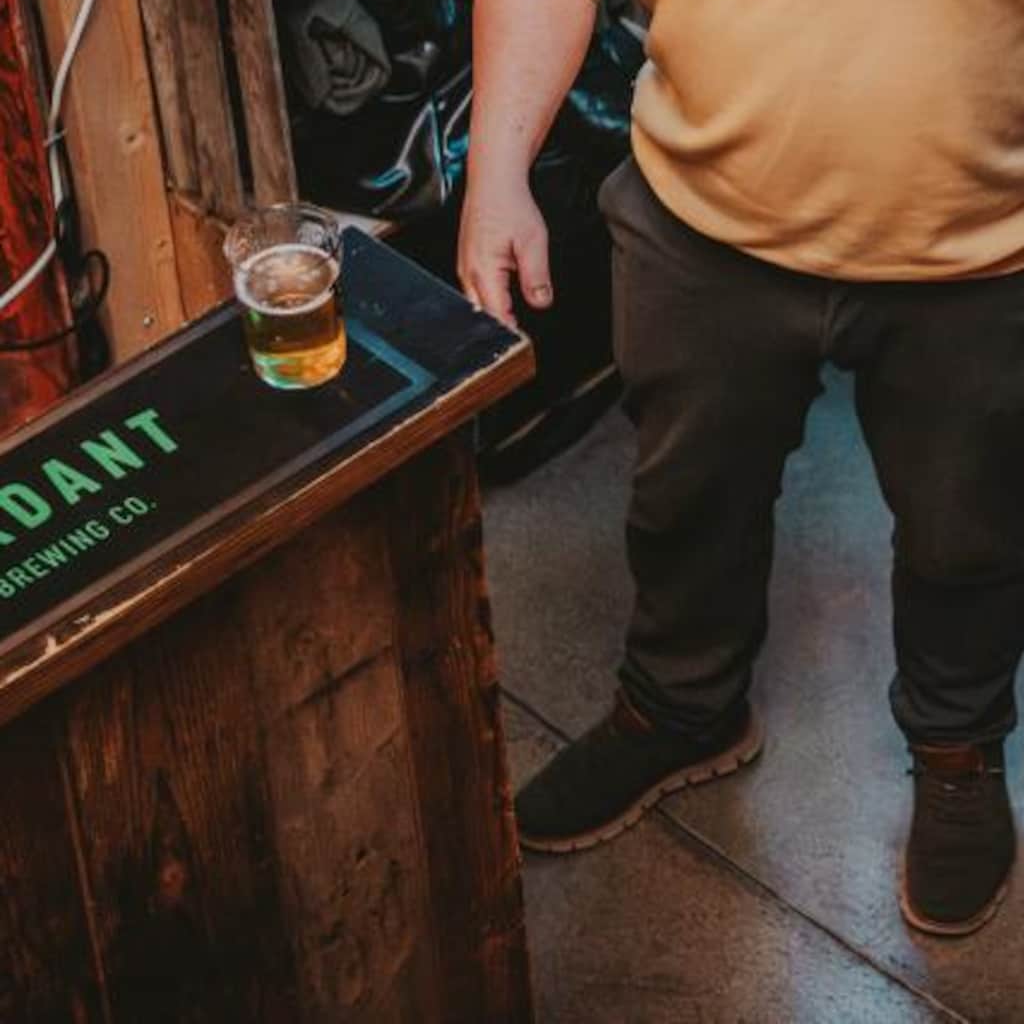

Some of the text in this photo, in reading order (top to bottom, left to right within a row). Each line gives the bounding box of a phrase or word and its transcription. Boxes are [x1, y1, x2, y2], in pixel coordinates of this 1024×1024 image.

[0, 407, 179, 546] DANT
[0, 495, 157, 598] BREWING CO.
